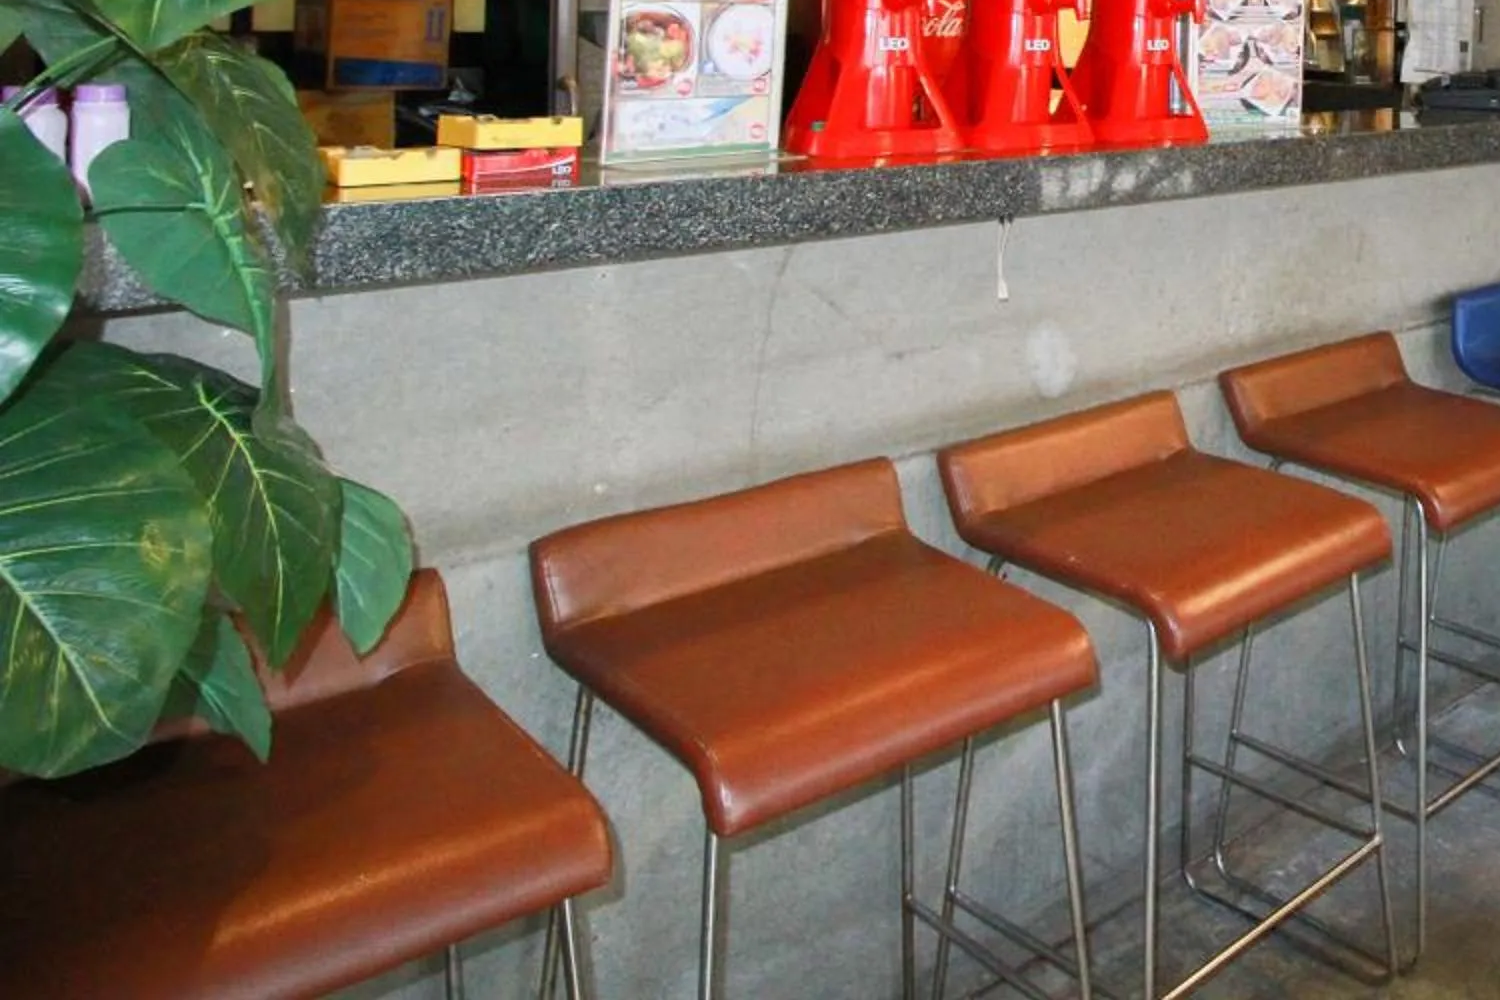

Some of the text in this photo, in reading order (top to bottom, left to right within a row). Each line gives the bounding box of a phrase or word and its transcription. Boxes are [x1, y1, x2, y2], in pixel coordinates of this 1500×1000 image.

[879, 36, 909, 51] LEO
[1024, 39, 1051, 51] LEO
[1147, 39, 1169, 51] LEO
